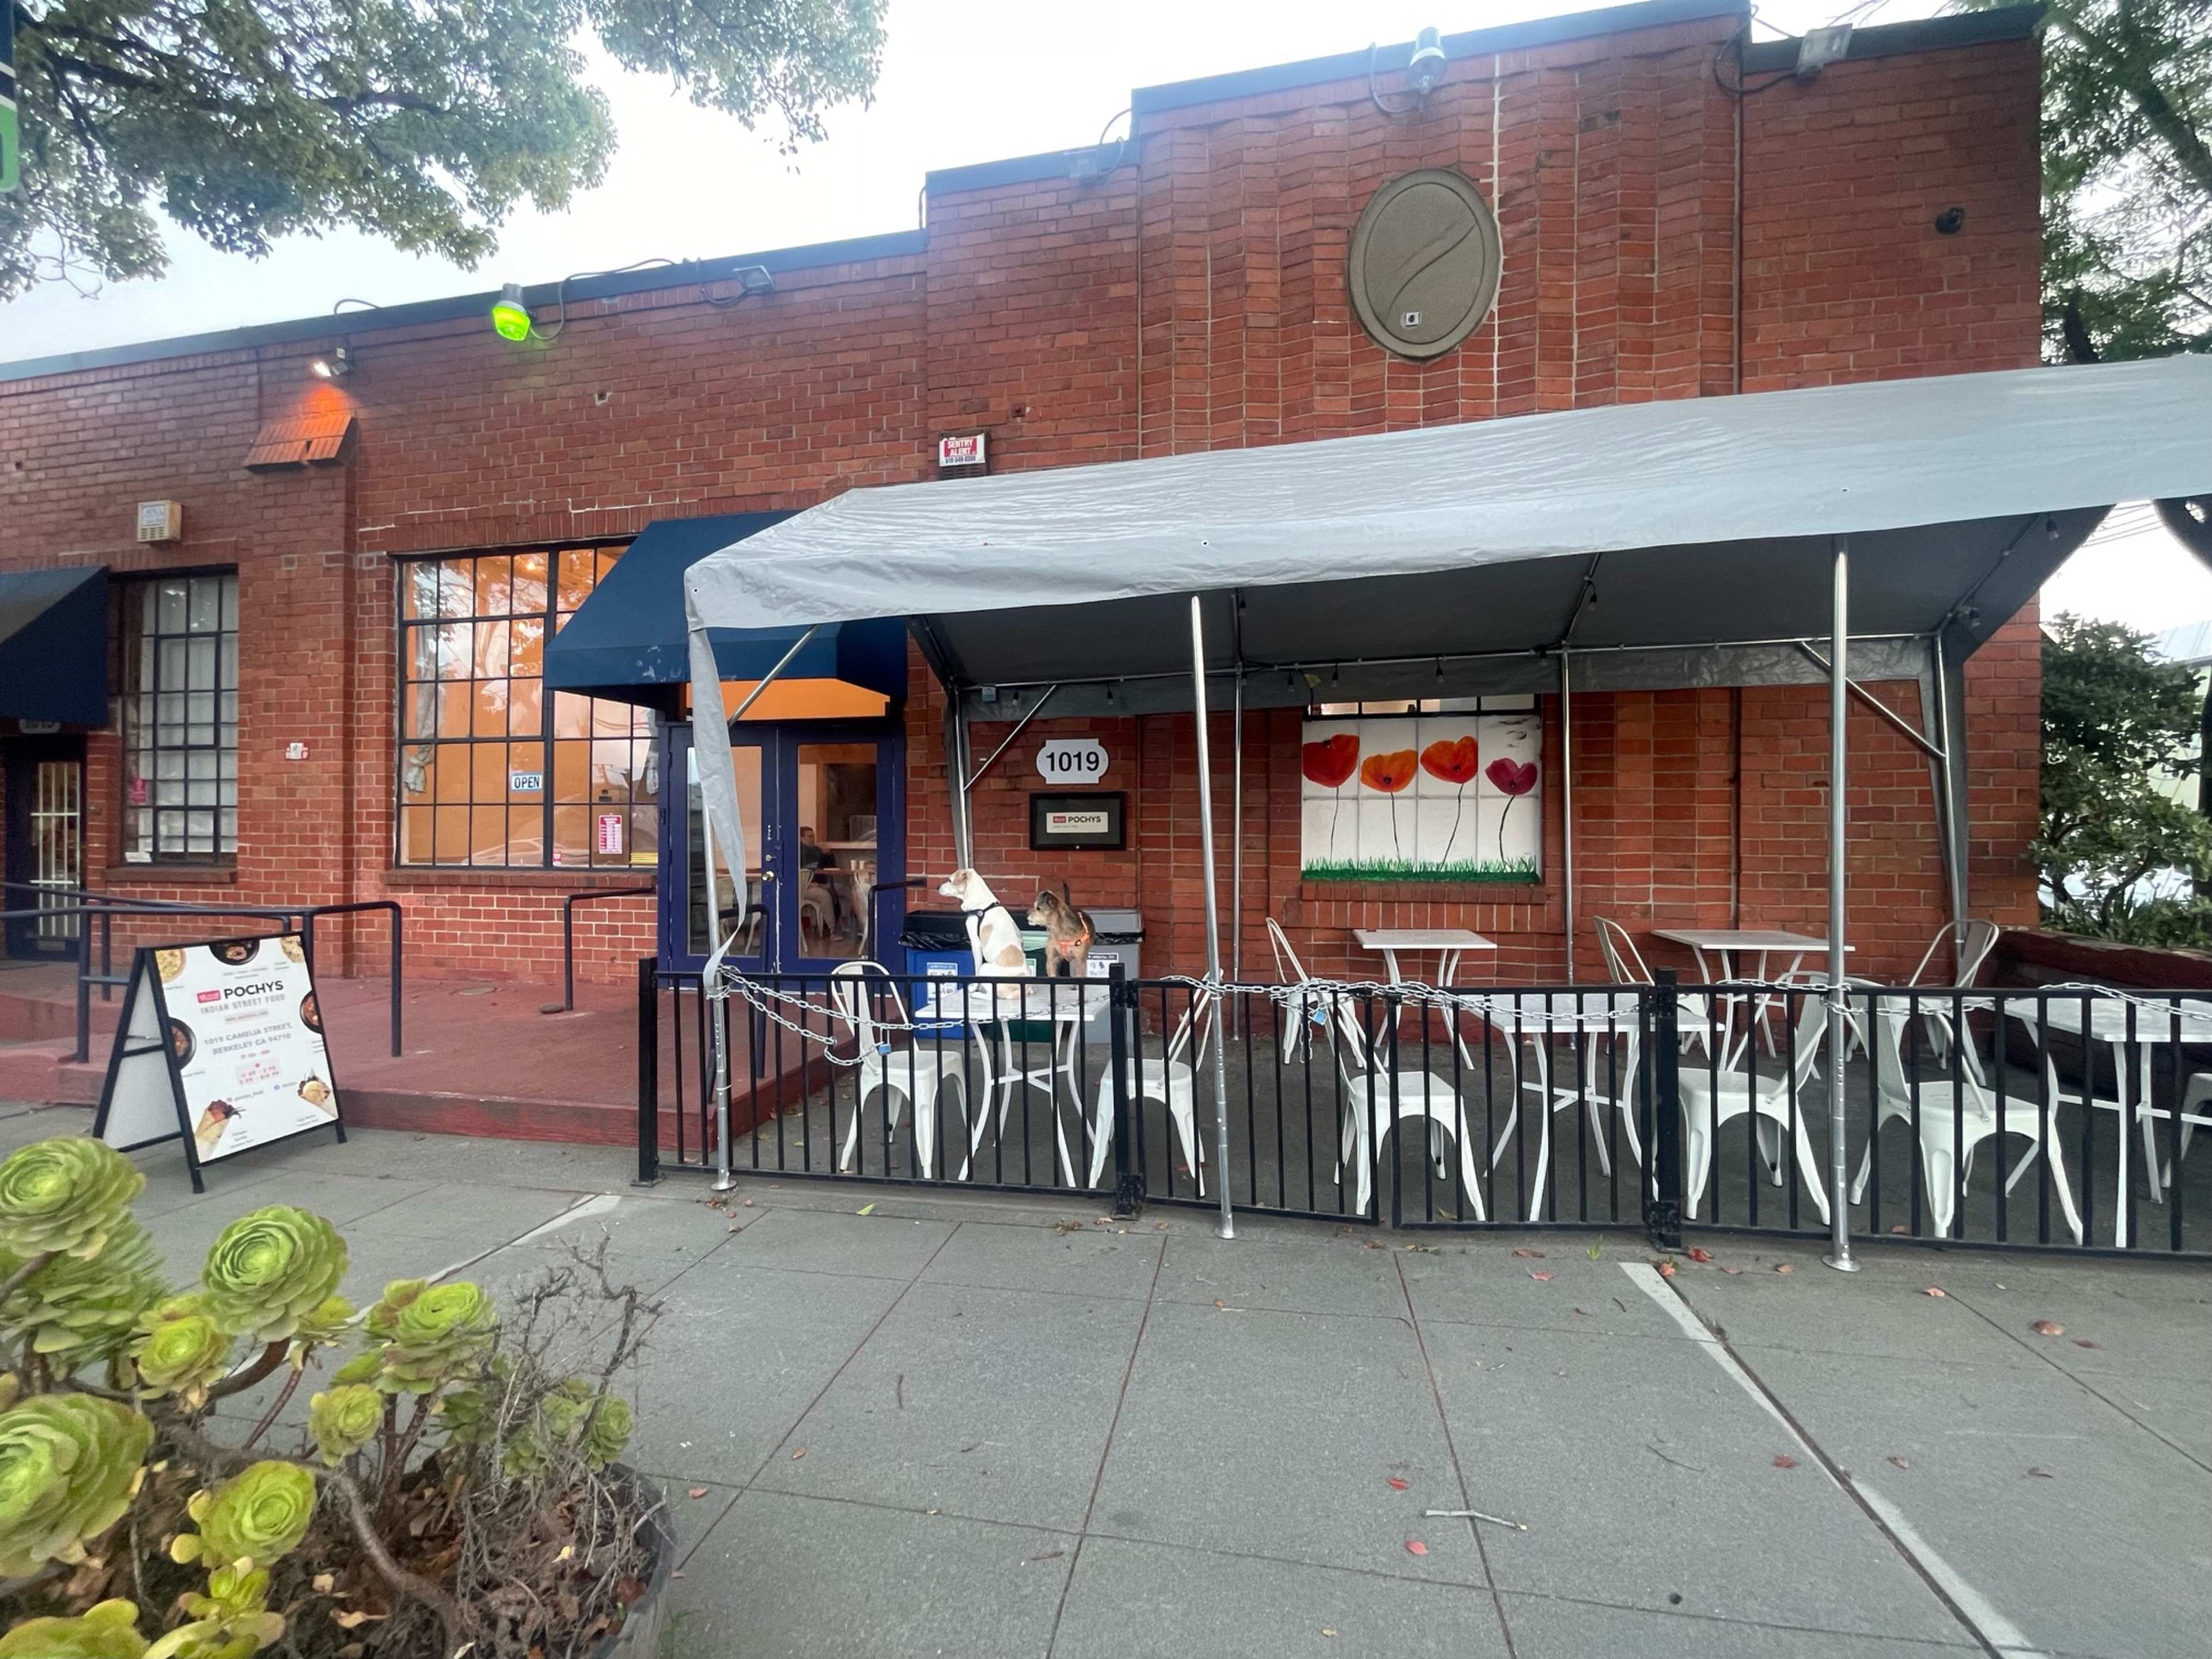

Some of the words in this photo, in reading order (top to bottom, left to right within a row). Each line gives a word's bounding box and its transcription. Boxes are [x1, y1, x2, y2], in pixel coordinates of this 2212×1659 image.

[950, 448, 971, 456] ALERT
[1046, 751, 1100, 771] 1019
[514, 777, 539, 788] OPEN
[224, 980, 283, 999] POCHYS
[200, 1003, 229, 1014] INDIAN
[232, 997, 262, 1009] STREET
[266, 994, 285, 1003] FOOD
[204, 1036, 224, 1045] 1019
[226, 1029, 262, 1040] CAMELIA
[264, 1022, 293, 1033] STREET,
[213, 1041, 253, 1055] BERKELEY
[268, 1033, 291, 1042] 94710
